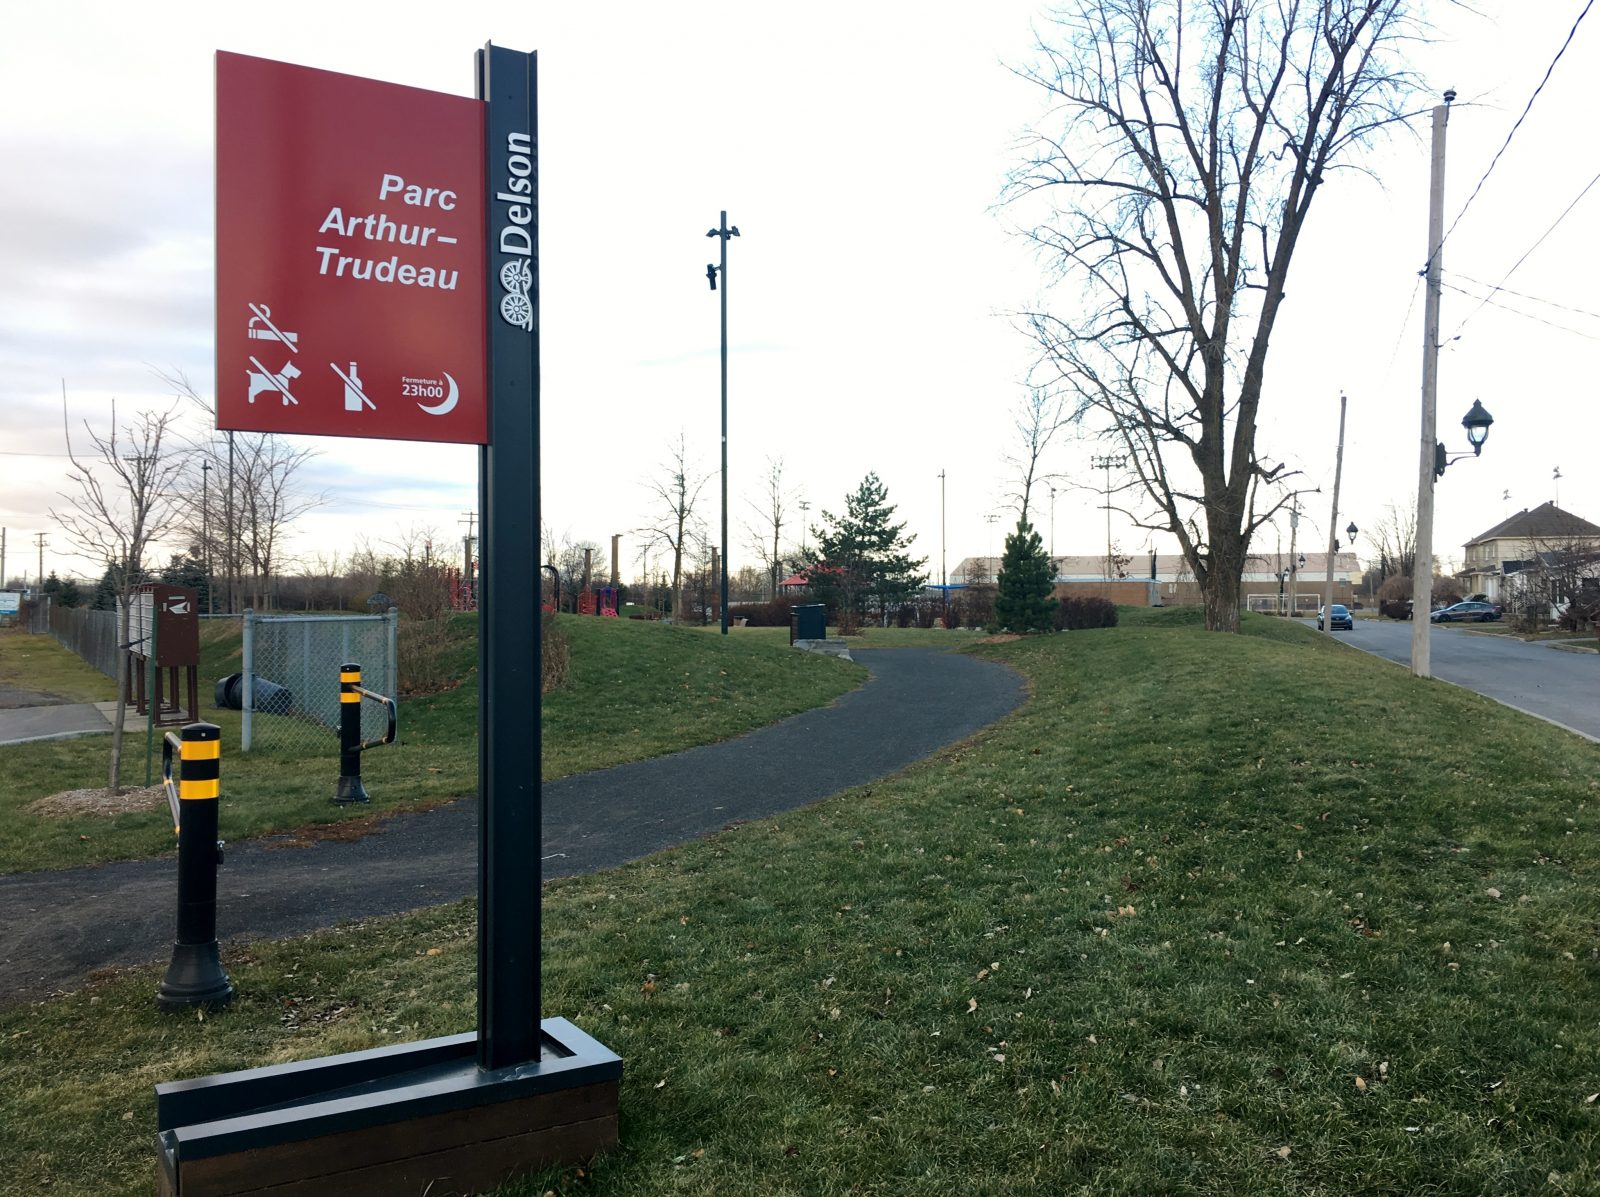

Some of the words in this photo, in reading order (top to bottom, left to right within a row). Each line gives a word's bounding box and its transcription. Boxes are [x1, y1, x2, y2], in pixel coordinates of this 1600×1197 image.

[378, 173, 457, 211] Parc
[497, 131, 532, 256] Delson
[318, 207, 458, 247] Arthur-
[315, 246, 459, 290] Trudeau
[401, 376, 438, 386] Fermeture
[401, 384, 444, 398] 23h00
